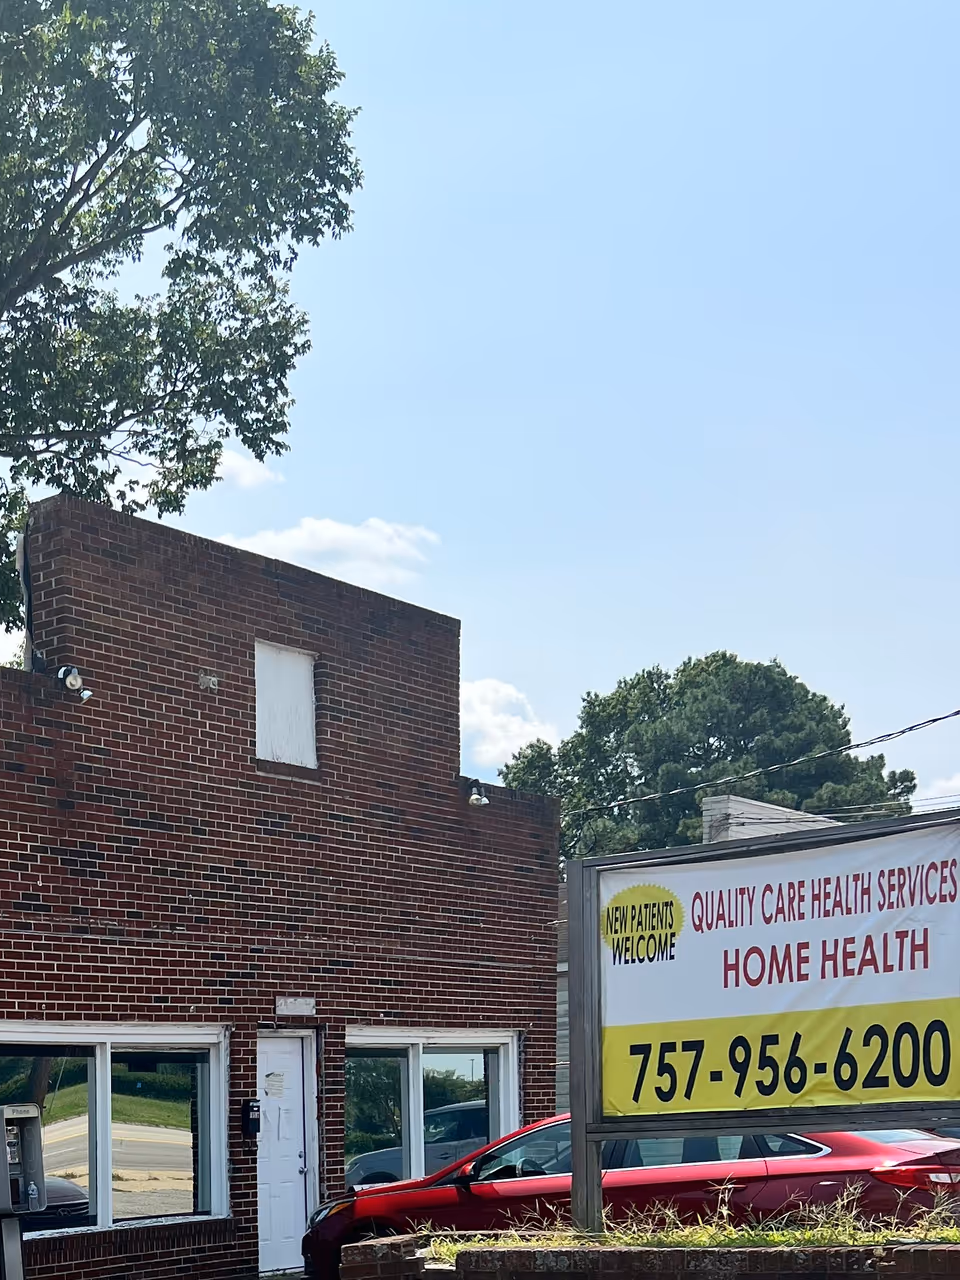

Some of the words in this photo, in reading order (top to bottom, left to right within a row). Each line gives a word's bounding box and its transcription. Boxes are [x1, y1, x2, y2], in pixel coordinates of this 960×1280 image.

[606, 905, 628, 935] NEW
[630, 900, 674, 933] PATIENTS
[691, 886, 756, 934] QUALITY
[761, 880, 806, 925] CARE
[811, 871, 872, 919] HEALTH
[877, 858, 958, 912] SERVICES
[612, 932, 676, 965] WELCOME
[723, 941, 810, 989] HOME
[820, 927, 930, 980] HEALTH
[629, 1019, 951, 1104] 757-956-6200
